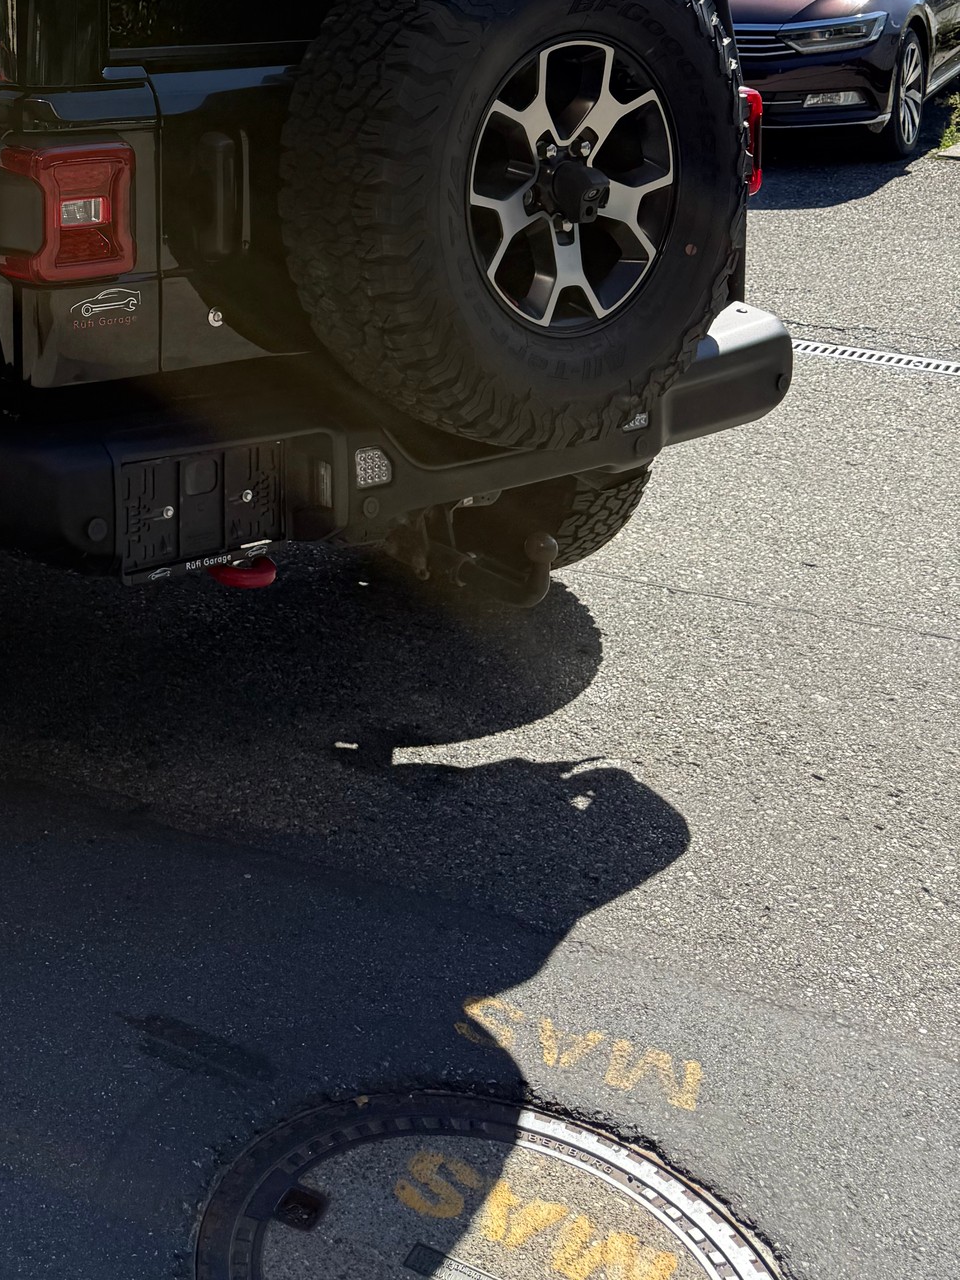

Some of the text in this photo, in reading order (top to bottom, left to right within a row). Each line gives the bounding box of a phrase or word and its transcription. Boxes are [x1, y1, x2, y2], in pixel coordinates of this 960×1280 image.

[98, 315, 138, 326] Garage
[185, 554, 231, 570] Rüfi Garage
